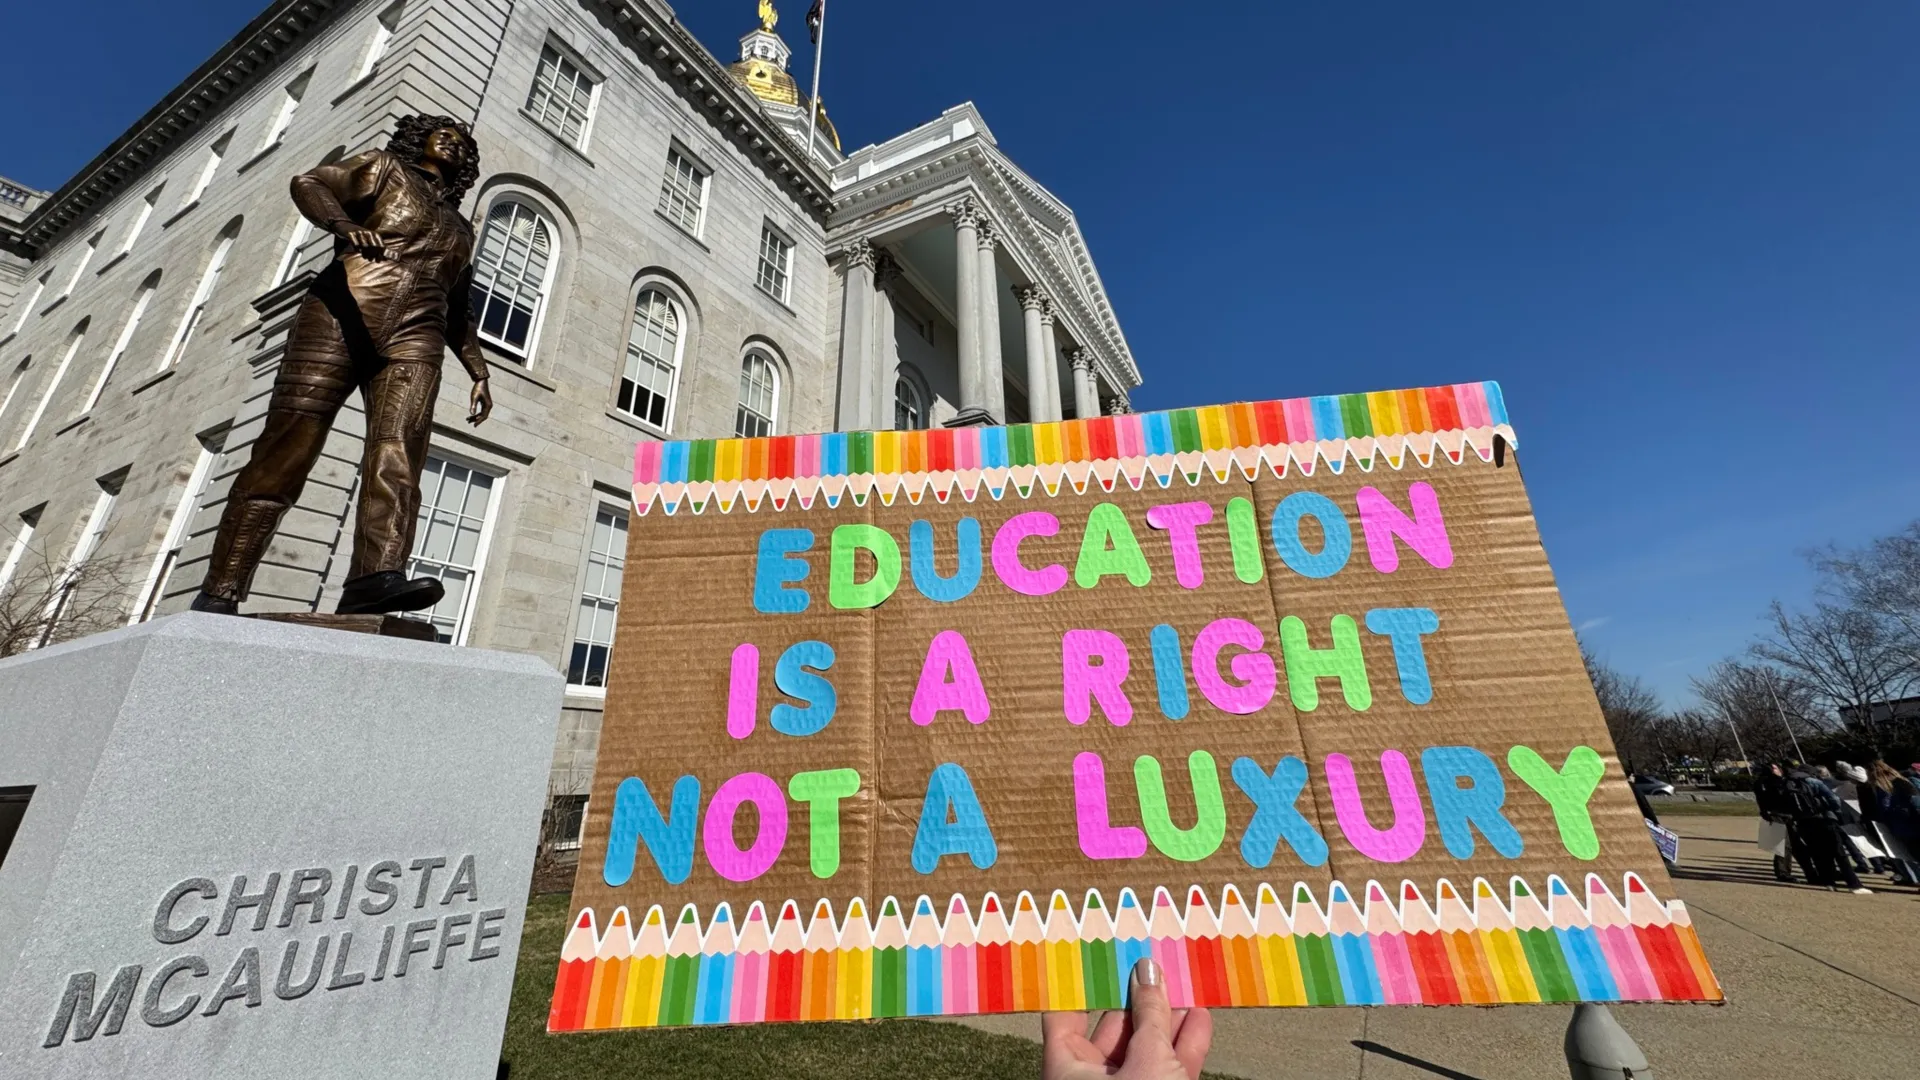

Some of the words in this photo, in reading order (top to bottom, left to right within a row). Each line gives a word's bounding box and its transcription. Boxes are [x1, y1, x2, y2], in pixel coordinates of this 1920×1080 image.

[754, 481, 1454, 614] EDUCATION
[726, 641, 836, 740] IS
[909, 630, 991, 726] A
[1062, 609, 1438, 727] RIGHT
[604, 768, 859, 886] NOT
[912, 764, 996, 874] A
[1072, 746, 1605, 867] LUXURY
[153, 854, 478, 944] CHRISTA
[43, 908, 506, 1048] MCAULIFFE
